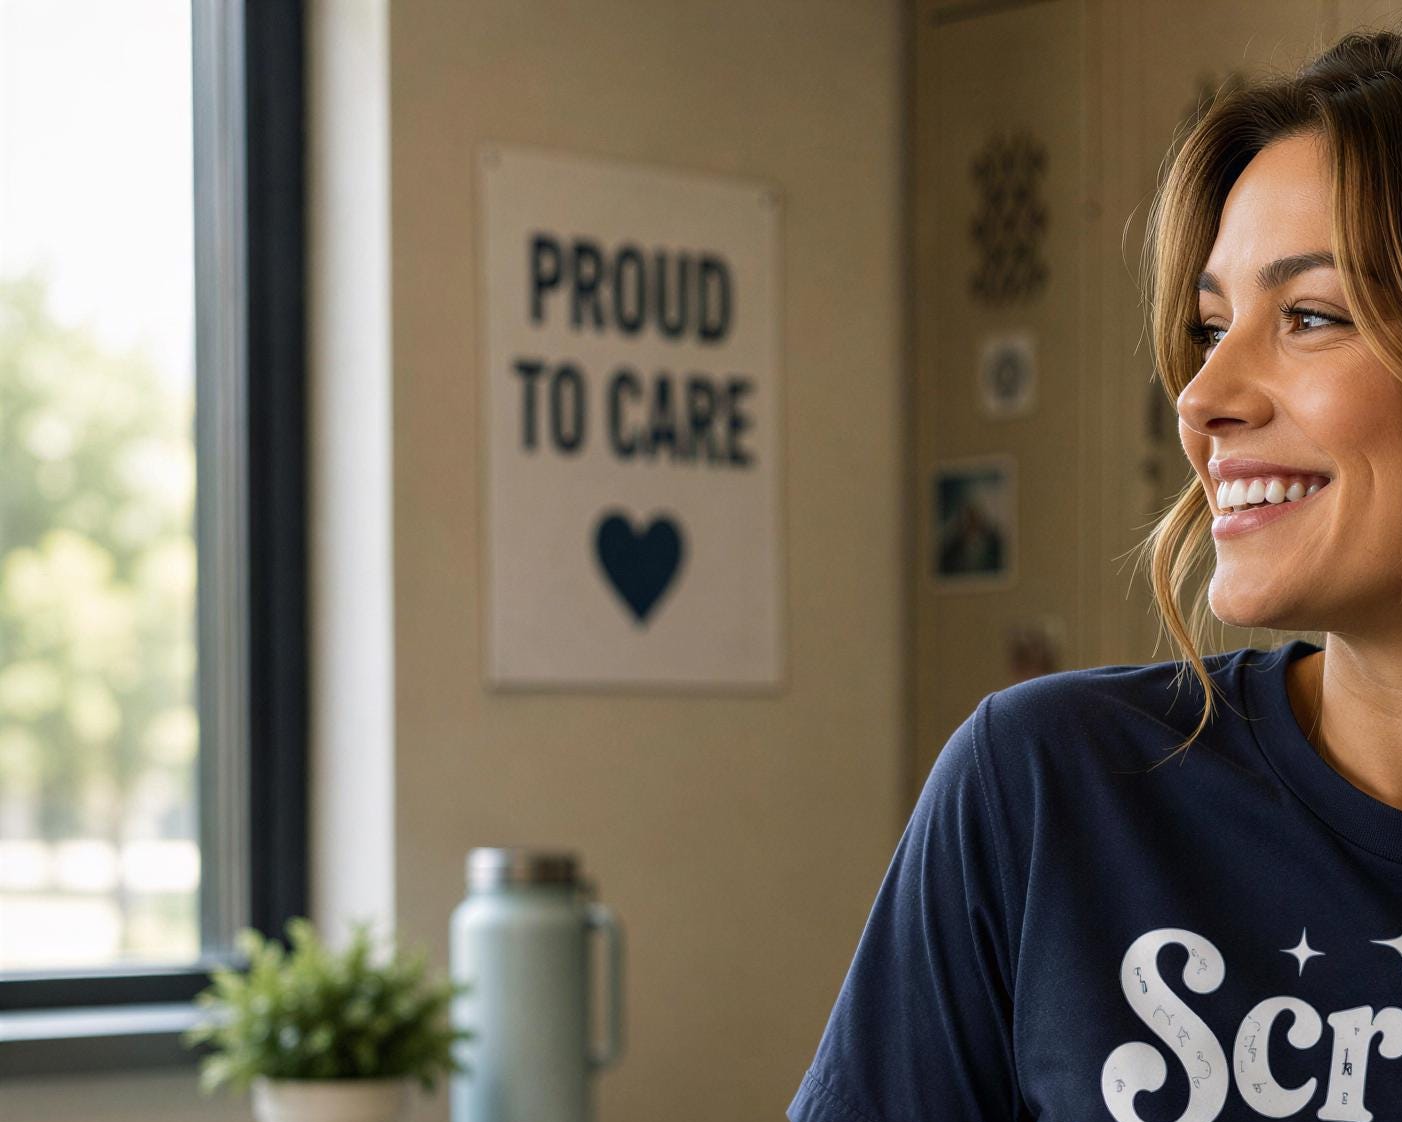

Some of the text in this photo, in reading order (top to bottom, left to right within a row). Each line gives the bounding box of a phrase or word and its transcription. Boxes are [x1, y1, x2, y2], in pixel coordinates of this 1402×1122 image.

[529, 233, 735, 346] PROUD
[513, 359, 754, 470] TO CARE
